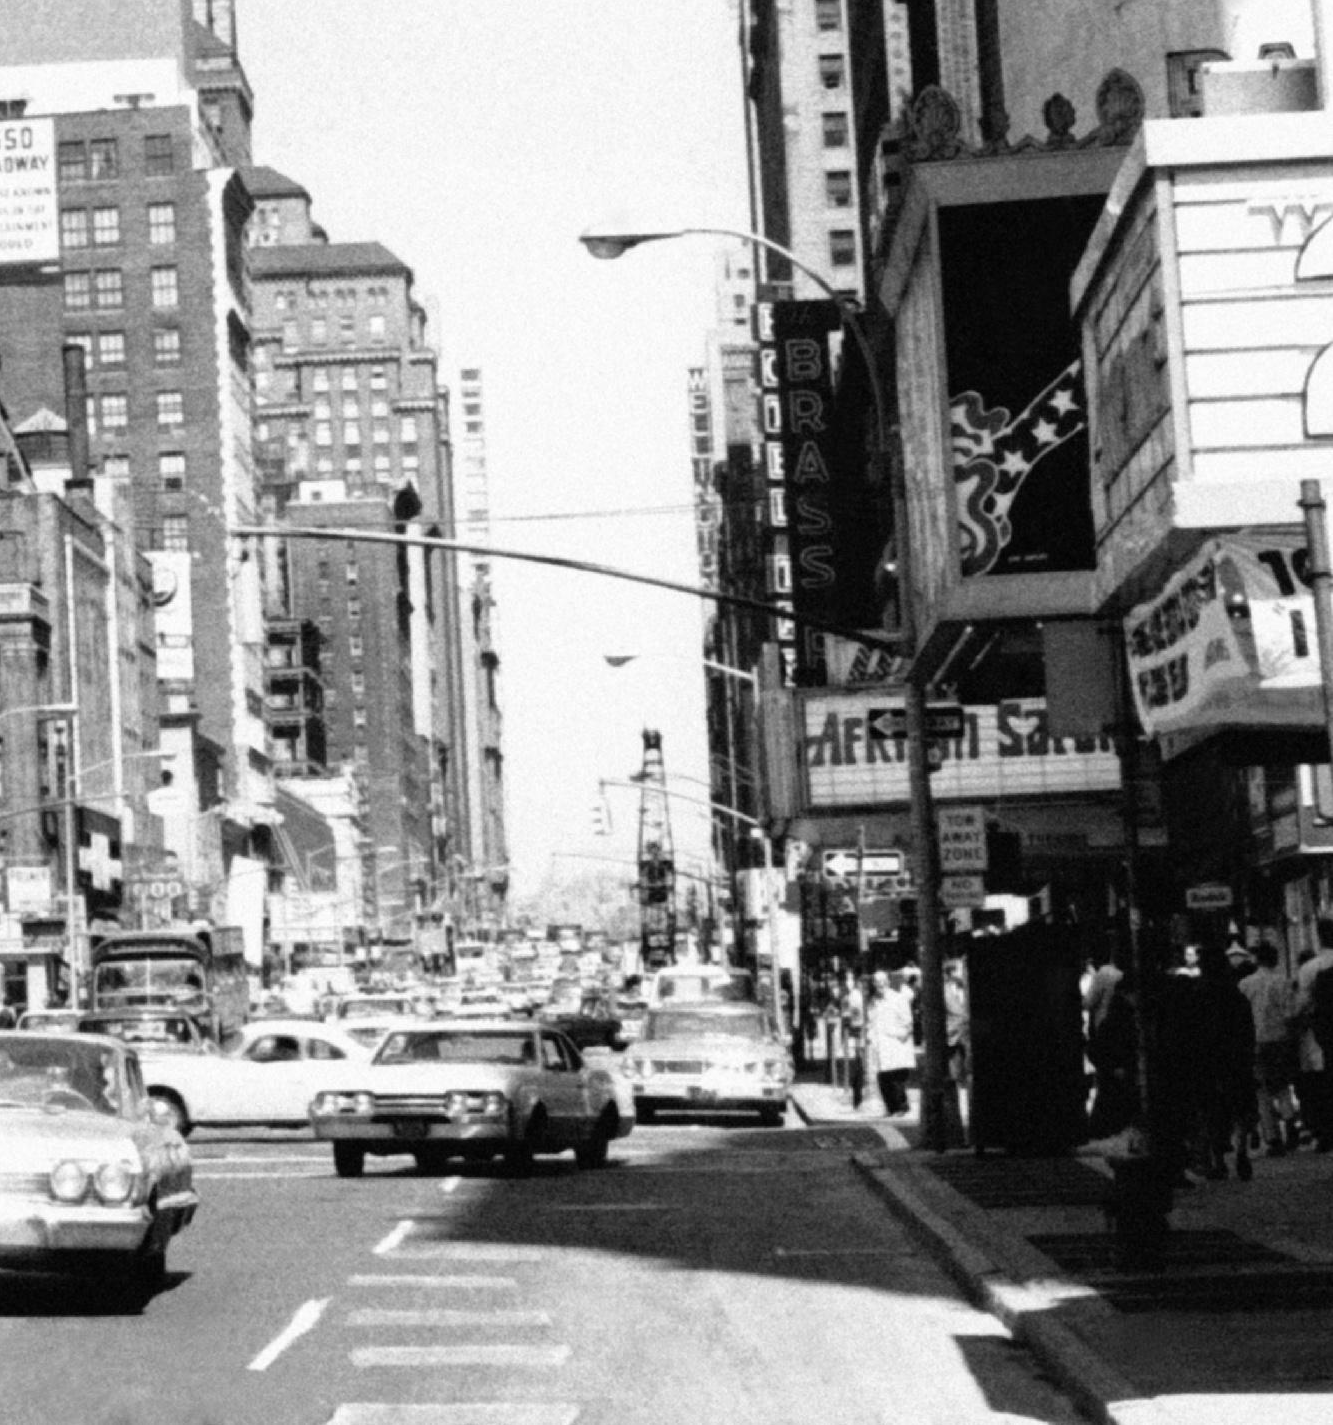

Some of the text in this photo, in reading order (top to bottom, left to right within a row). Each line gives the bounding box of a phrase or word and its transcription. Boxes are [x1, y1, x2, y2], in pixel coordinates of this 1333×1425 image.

[784, 338, 836, 589] BRASS
[945, 814, 976, 826] TOW
[943, 831, 981, 844] AWAY
[943, 846, 983, 862] ZONE
[951, 879, 972, 890] NO
